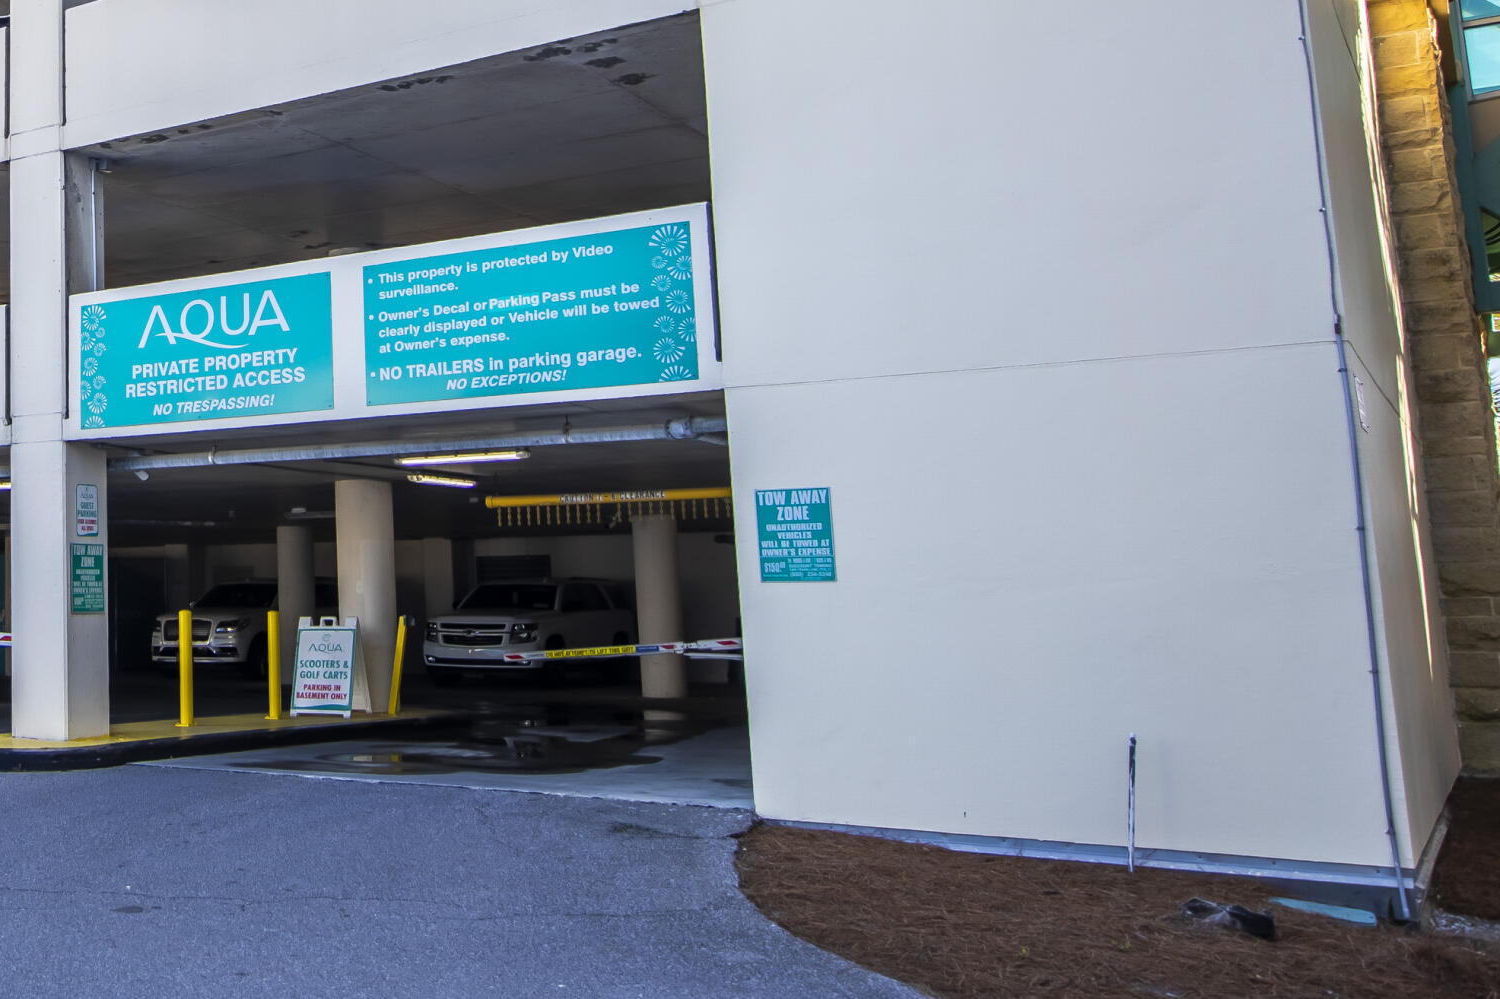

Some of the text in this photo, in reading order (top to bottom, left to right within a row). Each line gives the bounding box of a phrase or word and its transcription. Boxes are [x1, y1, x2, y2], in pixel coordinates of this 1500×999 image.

[379, 243, 613, 284] This property is protected by Video
[379, 281, 458, 299] surveillance.
[379, 281, 639, 323] Owner's Decal or Parking Pass must be
[138, 290, 290, 349] AQUA
[379, 296, 659, 338] clearly displayed or Vehicle will be towed
[379, 331, 510, 353] at Owner's expense.
[132, 348, 297, 379] PRIVATE PROPERTY
[379, 345, 642, 381] NO TRAILERS in parking garage.
[126, 367, 305, 399] RESTRICTED ACCESS
[446, 369, 566, 391] NO EXCEPTIONS!
[153, 394, 274, 416] NO TRESPASSING!
[757, 489, 827, 506] TOW AWAY
[777, 506, 809, 520] ZONE
[309, 644, 342, 653] AQUA
[300, 660, 340, 668] SCOOTERS
[300, 671, 347, 679] GOLF CARTS
